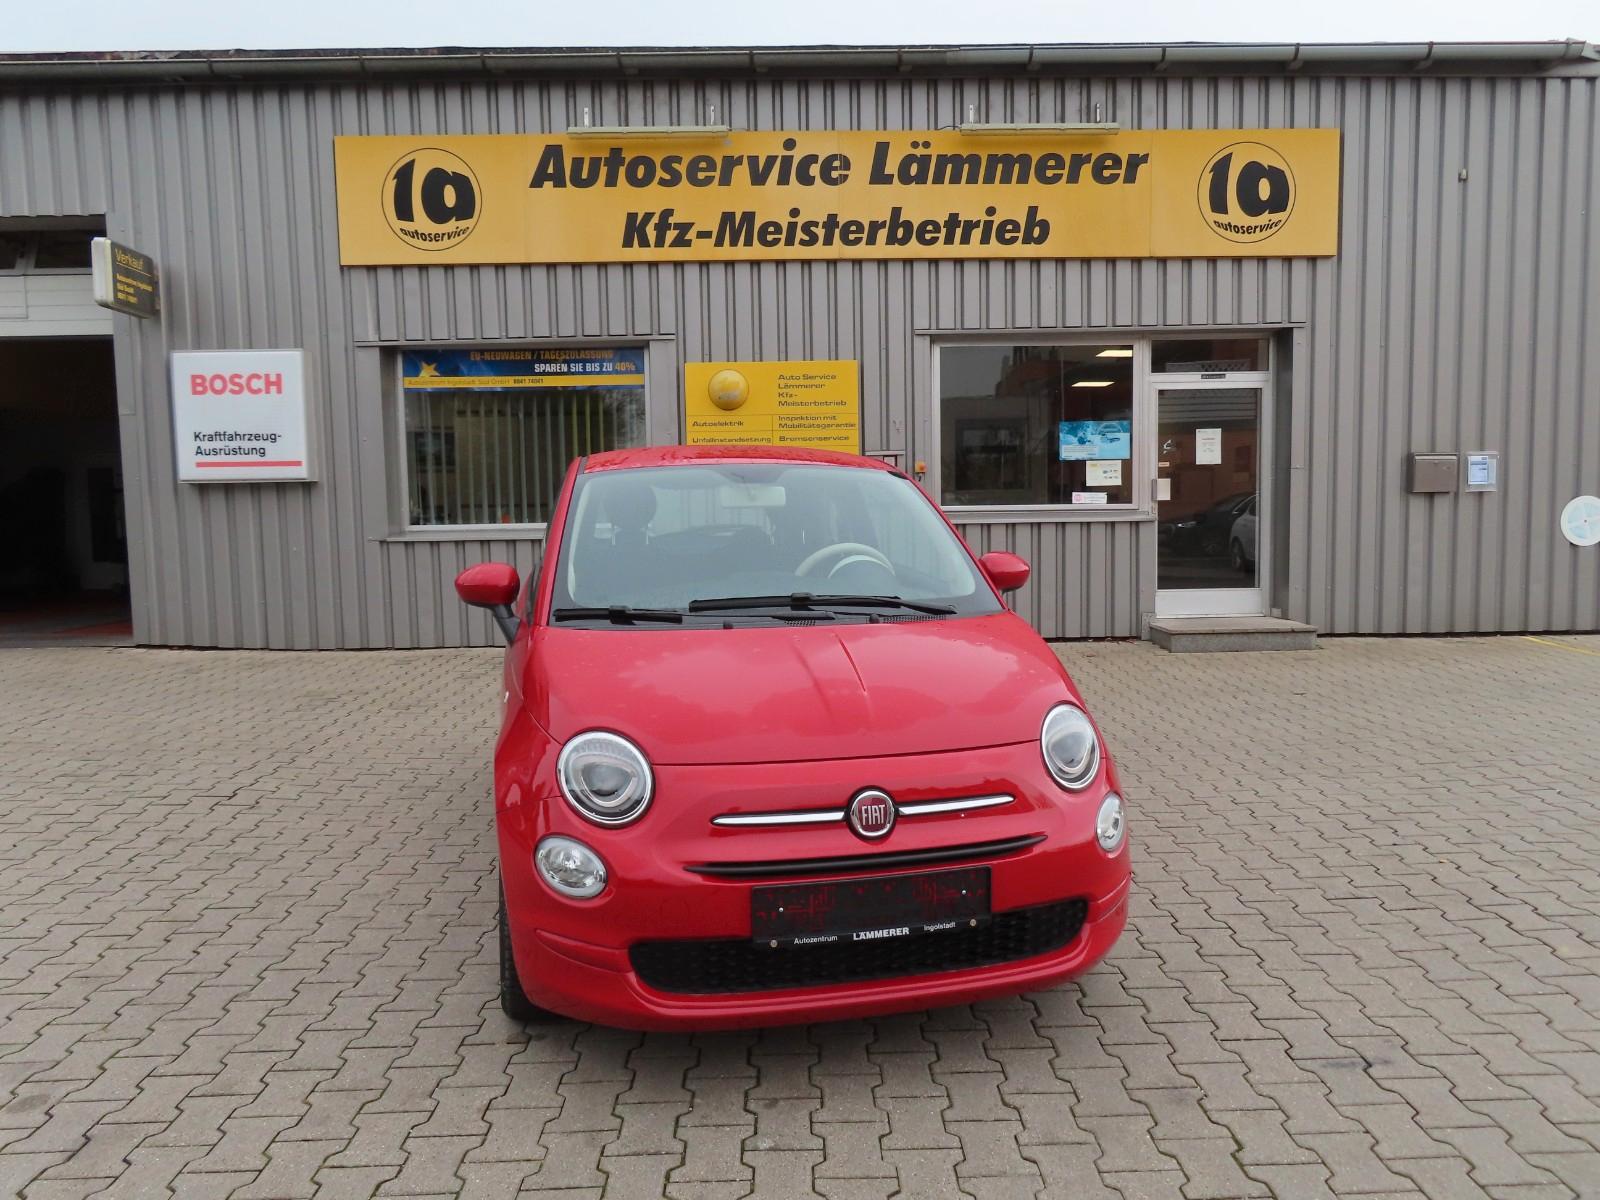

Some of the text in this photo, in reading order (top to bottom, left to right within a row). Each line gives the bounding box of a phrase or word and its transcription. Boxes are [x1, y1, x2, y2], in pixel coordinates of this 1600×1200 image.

[529, 138, 1149, 188] Autoservice Lämmerer
[392, 158, 476, 225] 1a
[1209, 152, 1290, 218] 1a
[400, 226, 470, 242] autoservice
[622, 206, 1051, 248] Kfz-Meisterbetrieb
[1213, 219, 1282, 235] autoservice
[115, 248, 144, 271] Verkauf
[534, 361, 636, 373] SPAREN SIE BIS ZU 40%
[802, 373, 837, 381] Service
[190, 373, 283, 396] BOSCH
[193, 431, 282, 443] Kraftfahrzeug-
[195, 445, 266, 457] Ausrüstung
[861, 804, 886, 826] FIAT
[793, 921, 956, 945] Autozentrum LÄMMERER Ingolstadt
